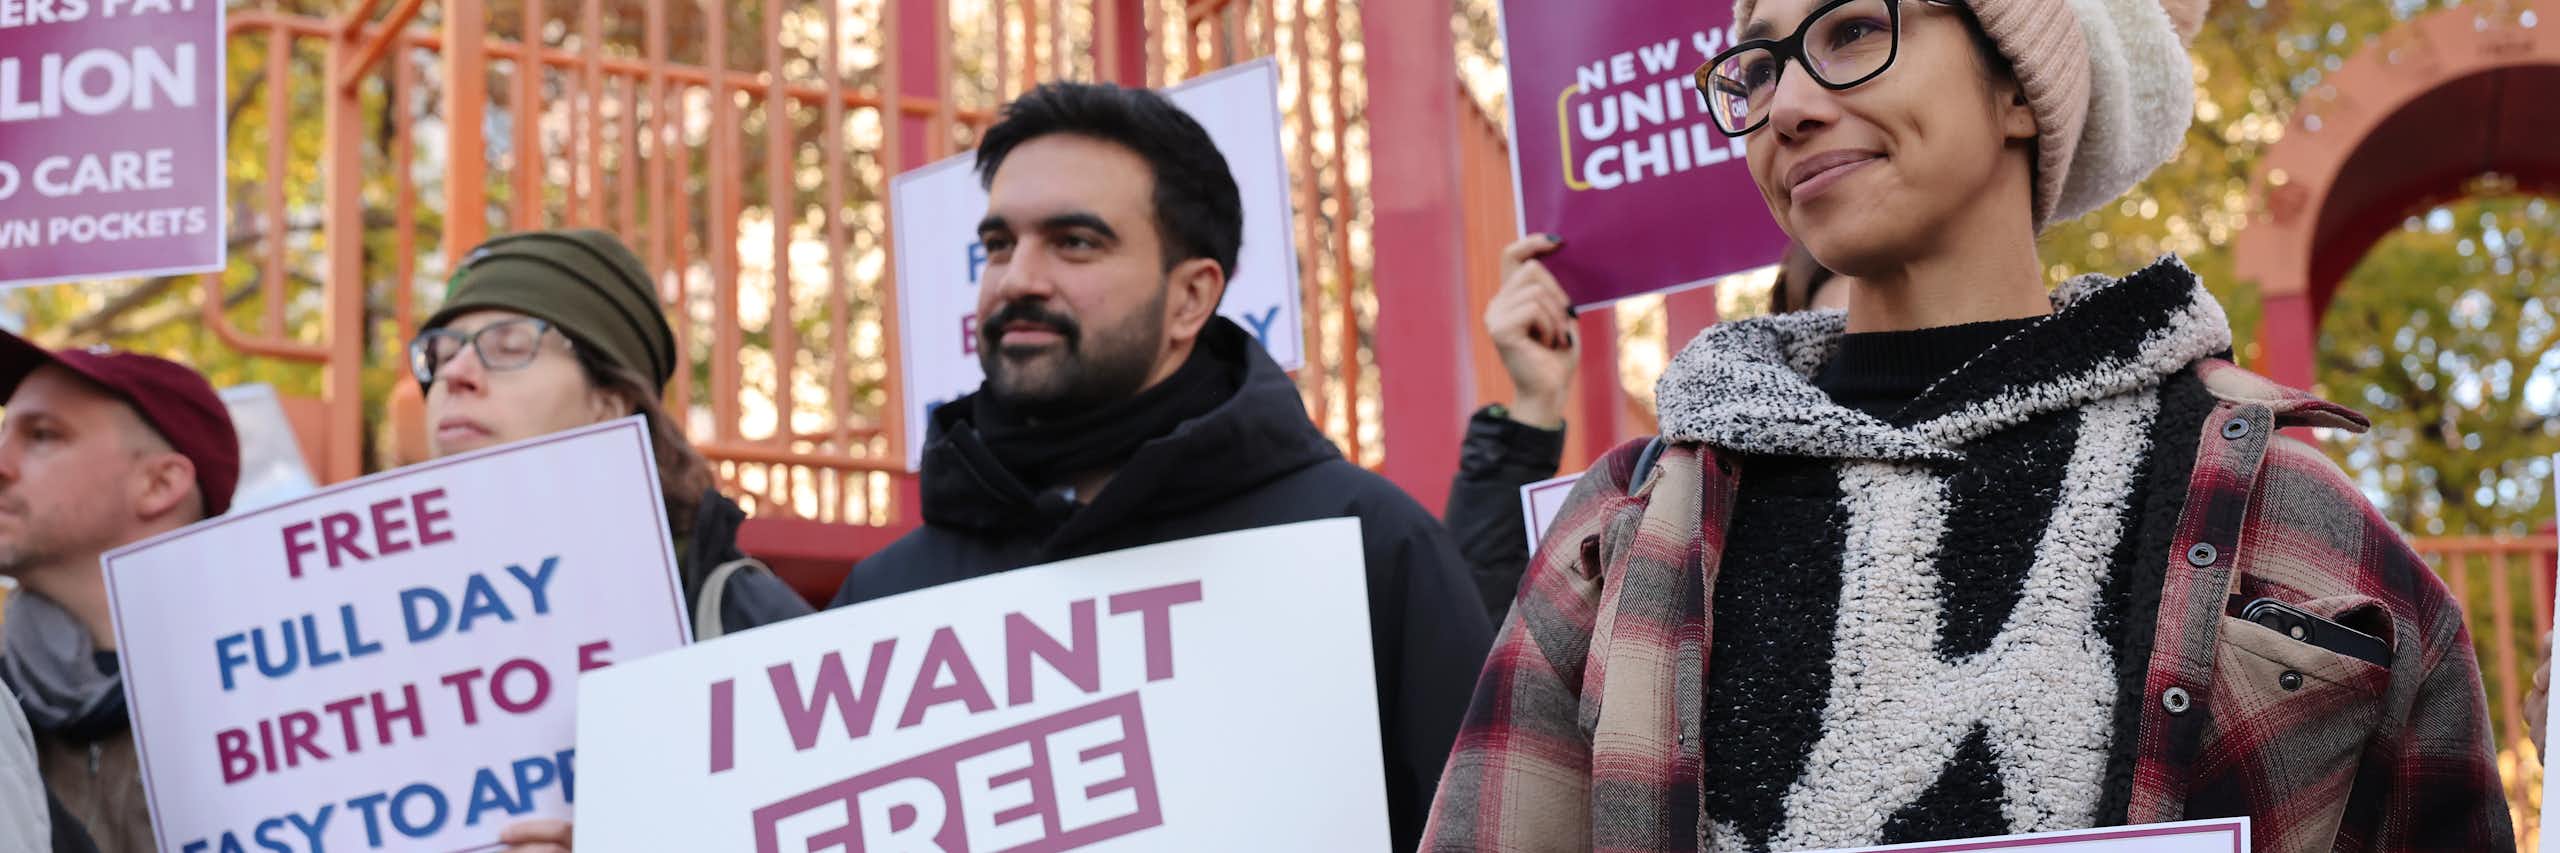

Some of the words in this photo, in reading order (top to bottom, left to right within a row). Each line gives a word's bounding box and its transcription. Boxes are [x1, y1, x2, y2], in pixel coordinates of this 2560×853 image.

[1577, 38, 1680, 94] NEW
[1692, 26, 1738, 60] Y
[33, 148, 174, 197] CARE
[49, 206, 206, 246] POCKETS
[282, 488, 454, 578] FREE
[216, 603, 383, 690] FULL
[400, 556, 560, 643] DAY
[709, 678, 735, 774] I
[766, 580, 1202, 752] WANT
[217, 683, 426, 785] BIRTH
[441, 657, 552, 726] TO
[346, 783, 450, 848] TO
